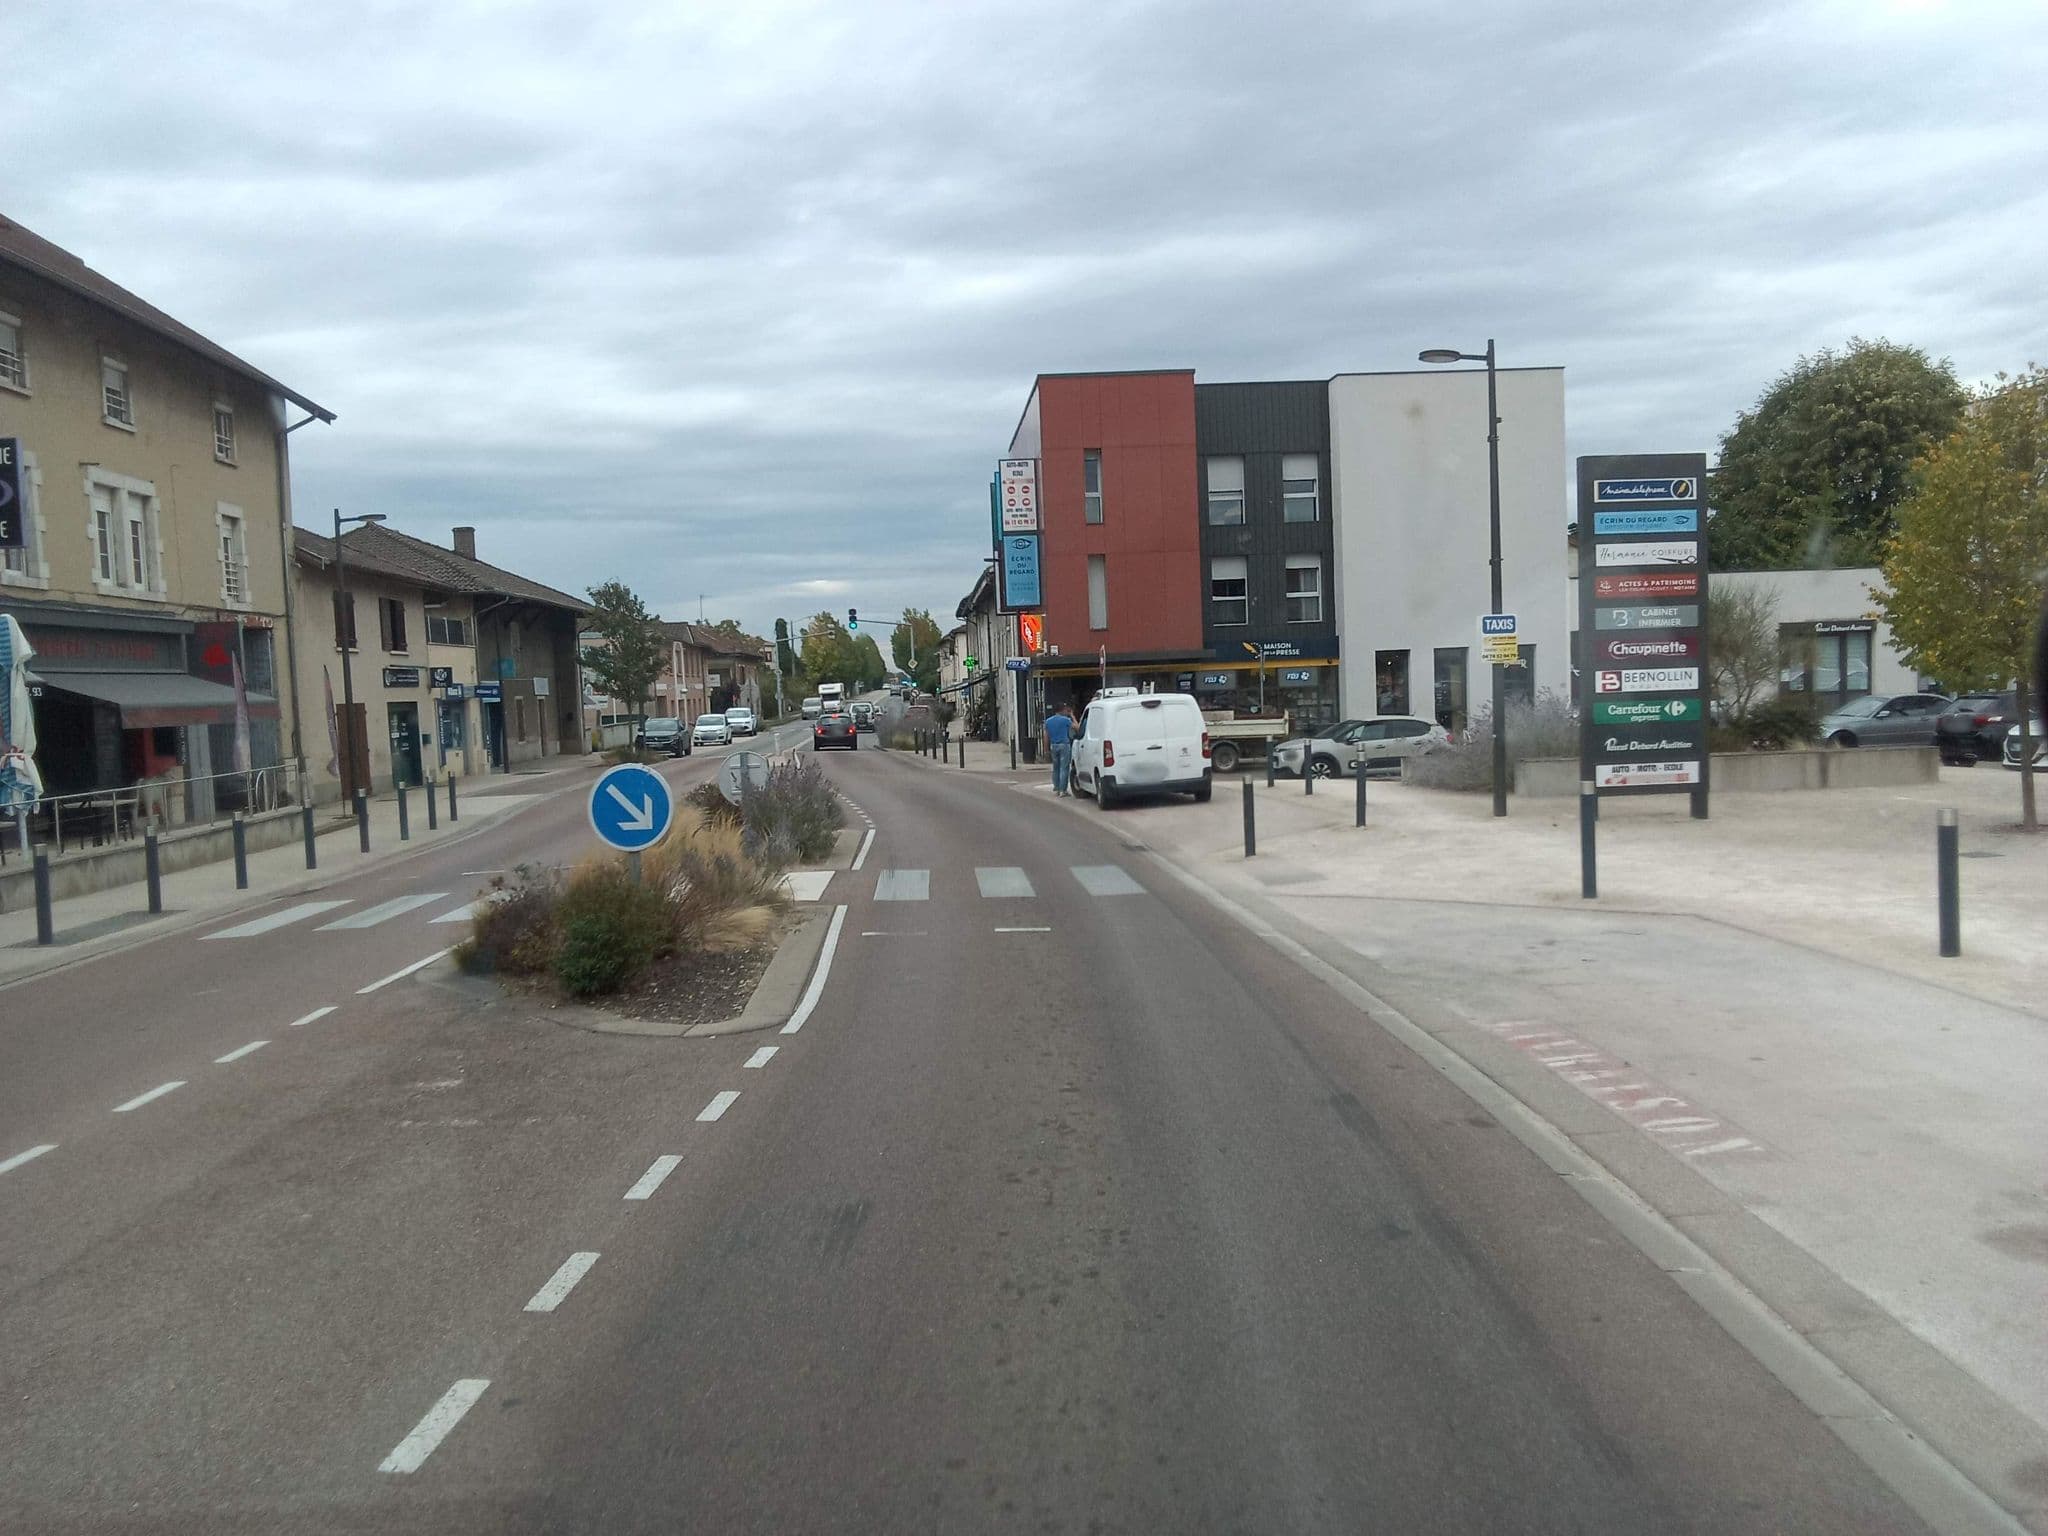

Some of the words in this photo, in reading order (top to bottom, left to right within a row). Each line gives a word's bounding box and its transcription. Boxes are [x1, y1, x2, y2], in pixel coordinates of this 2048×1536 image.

[0, 446, 12, 464] E
[1618, 580, 1641, 588] ACTES
[1650, 578, 1697, 586] PATRIMOINE
[1641, 607, 1679, 617] CABINET
[1484, 618, 1514, 630] TAXIS
[1639, 618, 1681, 628] INFIRMIER
[1263, 642, 1292, 650] MAISON
[1613, 641, 1687, 656] Chaupinette
[1623, 671, 1693, 683] BERNOLLIN
[1607, 703, 1661, 716] Carrefour
[1611, 765, 1630, 774] AUTO
[1637, 764, 1657, 773] MOTO
